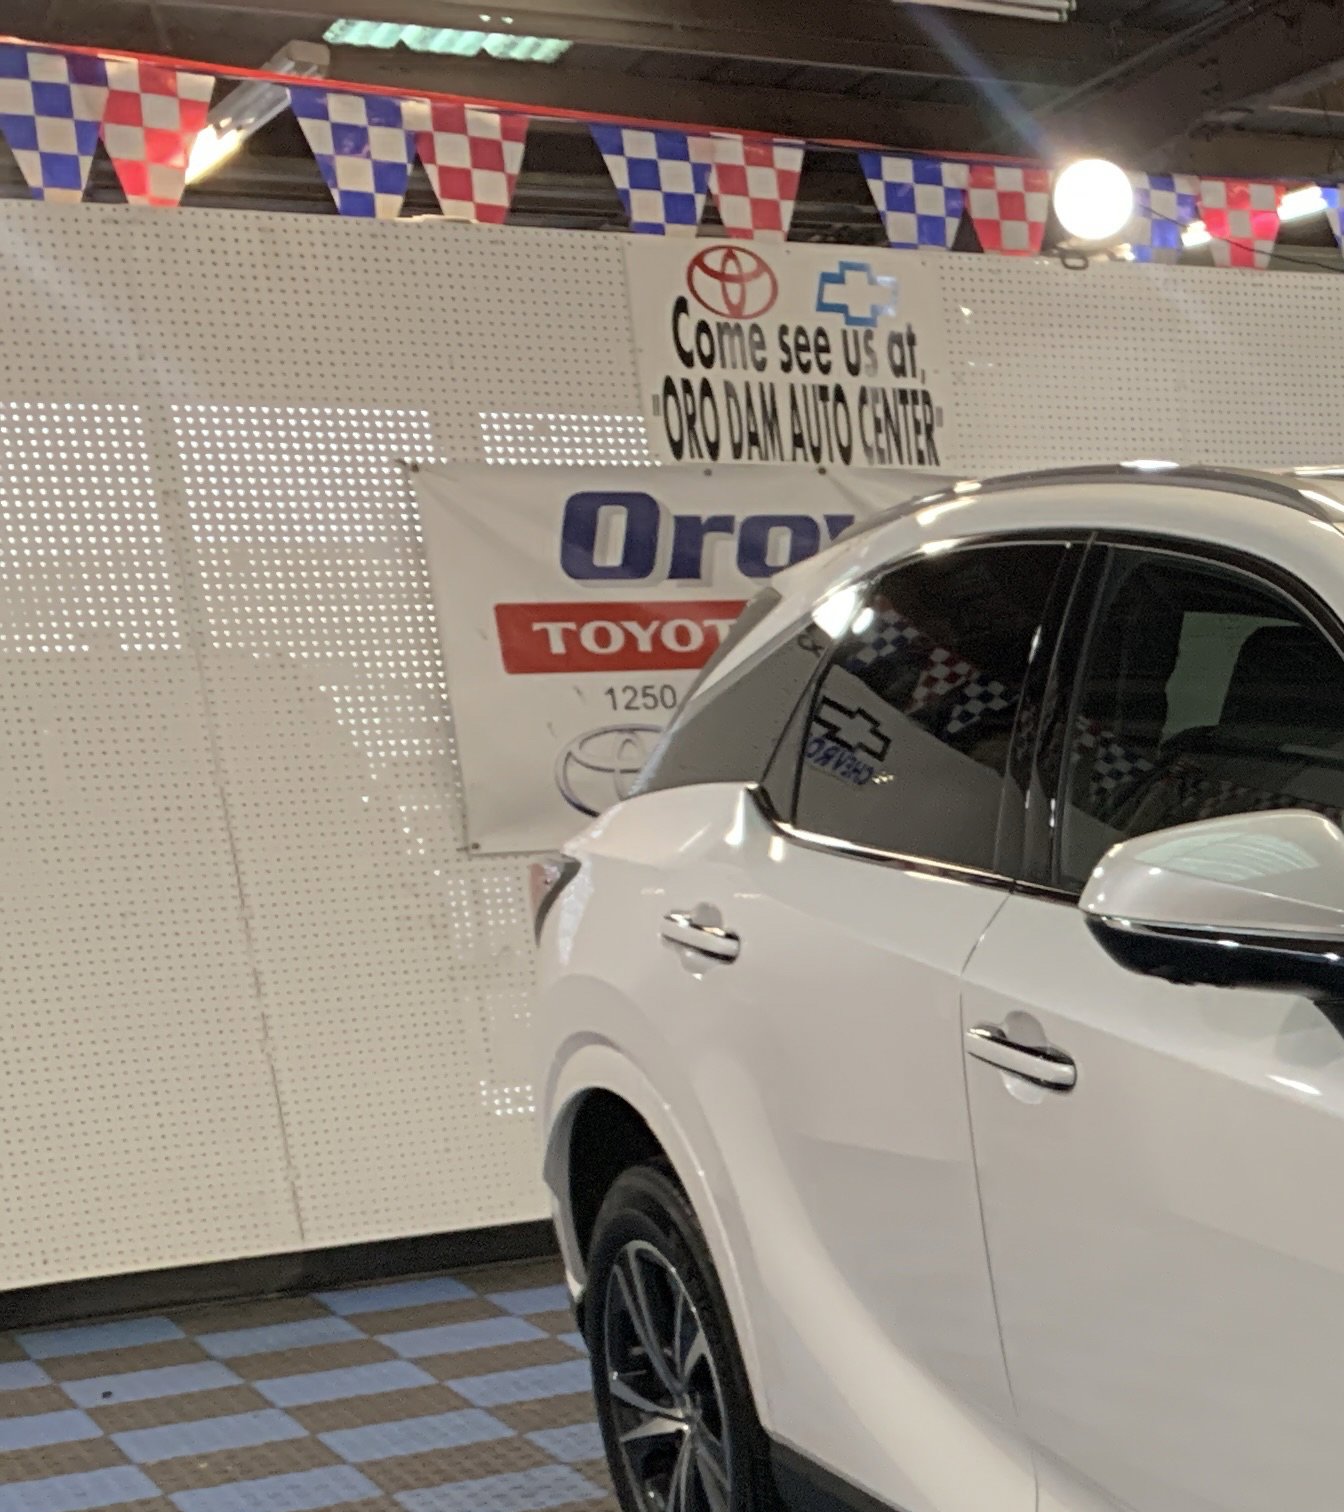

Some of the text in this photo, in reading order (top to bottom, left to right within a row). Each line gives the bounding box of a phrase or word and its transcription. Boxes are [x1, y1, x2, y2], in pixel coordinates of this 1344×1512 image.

[672, 296, 767, 372] Come
[778, 323, 832, 375] see
[842, 328, 878, 377] us
[723, 379, 785, 462] DAM
[789, 382, 851, 465] AUTO
[605, 684, 677, 711] 1250
